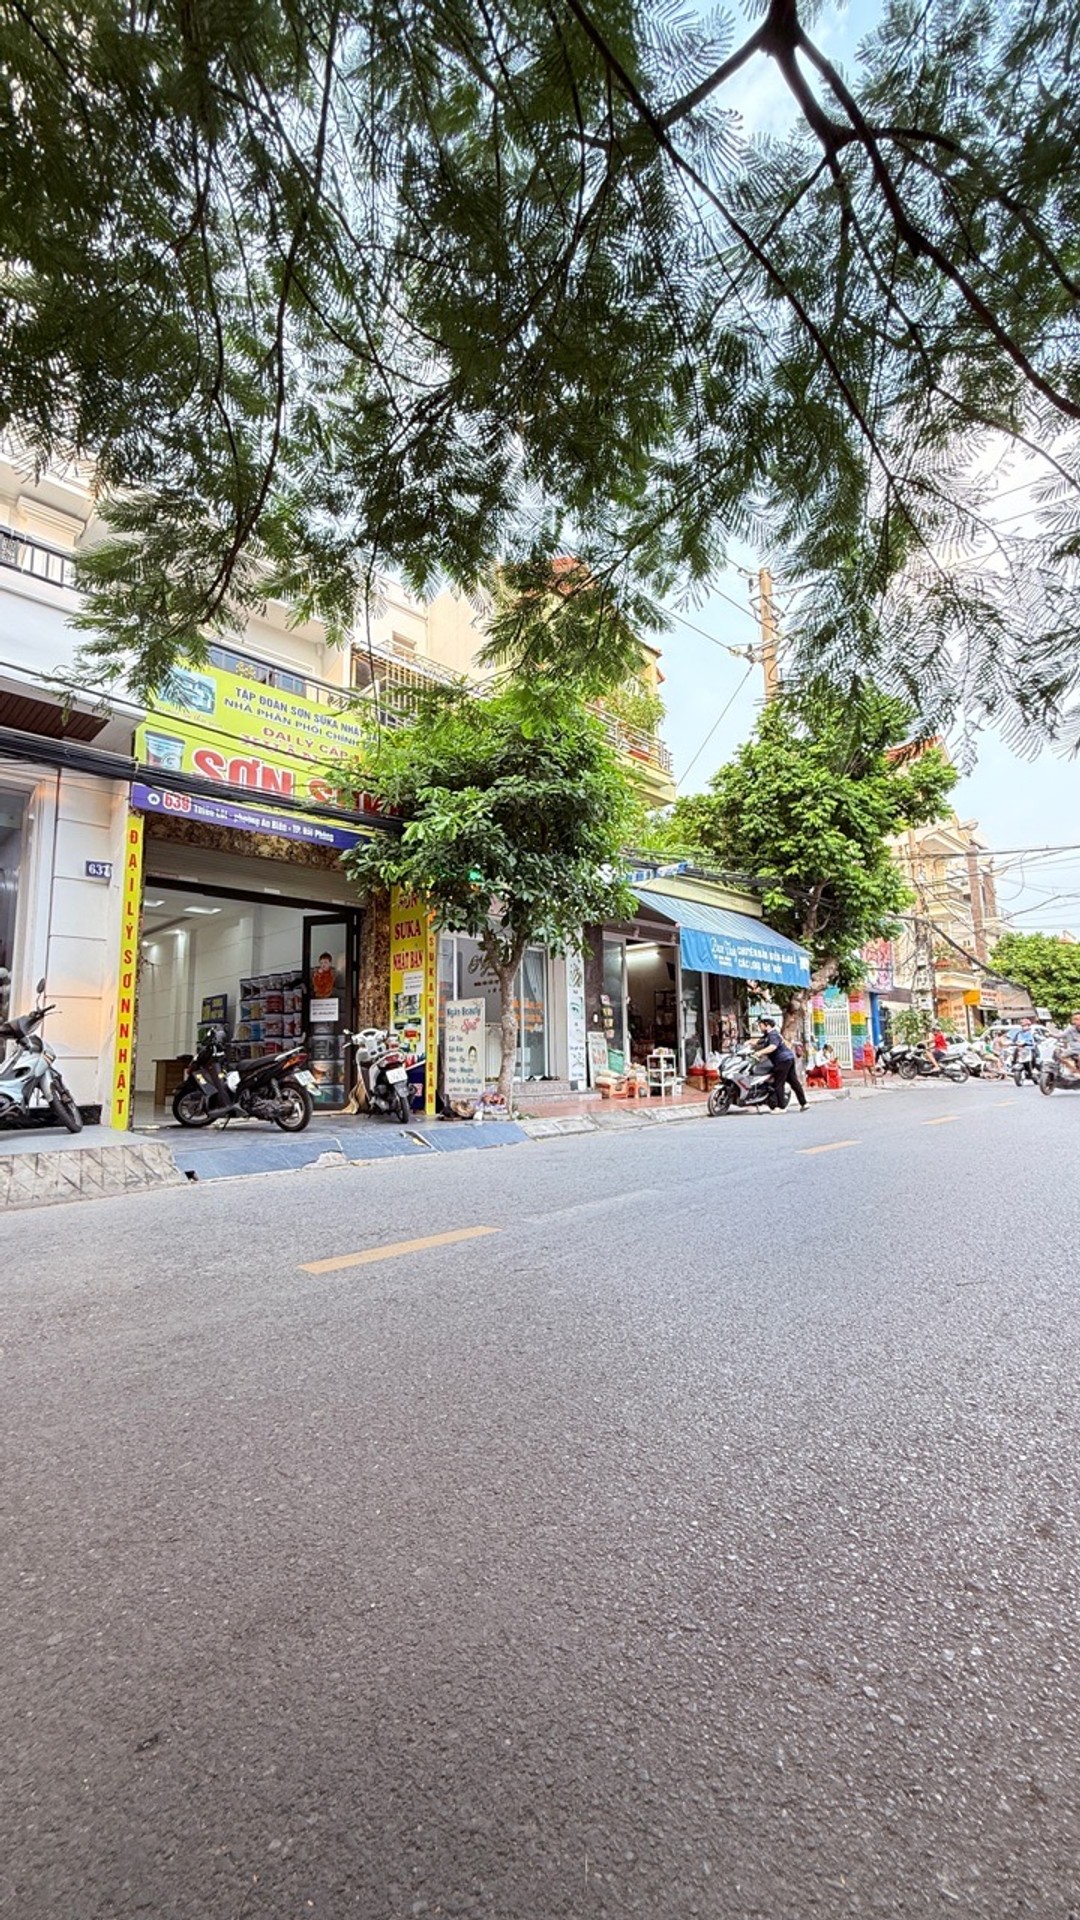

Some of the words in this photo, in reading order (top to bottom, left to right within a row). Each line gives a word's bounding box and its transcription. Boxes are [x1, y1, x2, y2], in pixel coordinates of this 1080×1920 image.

[224, 697, 253, 713] NHÀ
[257, 707, 291, 726] PHÂN
[291, 705, 311, 720] SƠN
[296, 734, 314, 748] LÝ
[394, 919, 421, 940] SUKA
